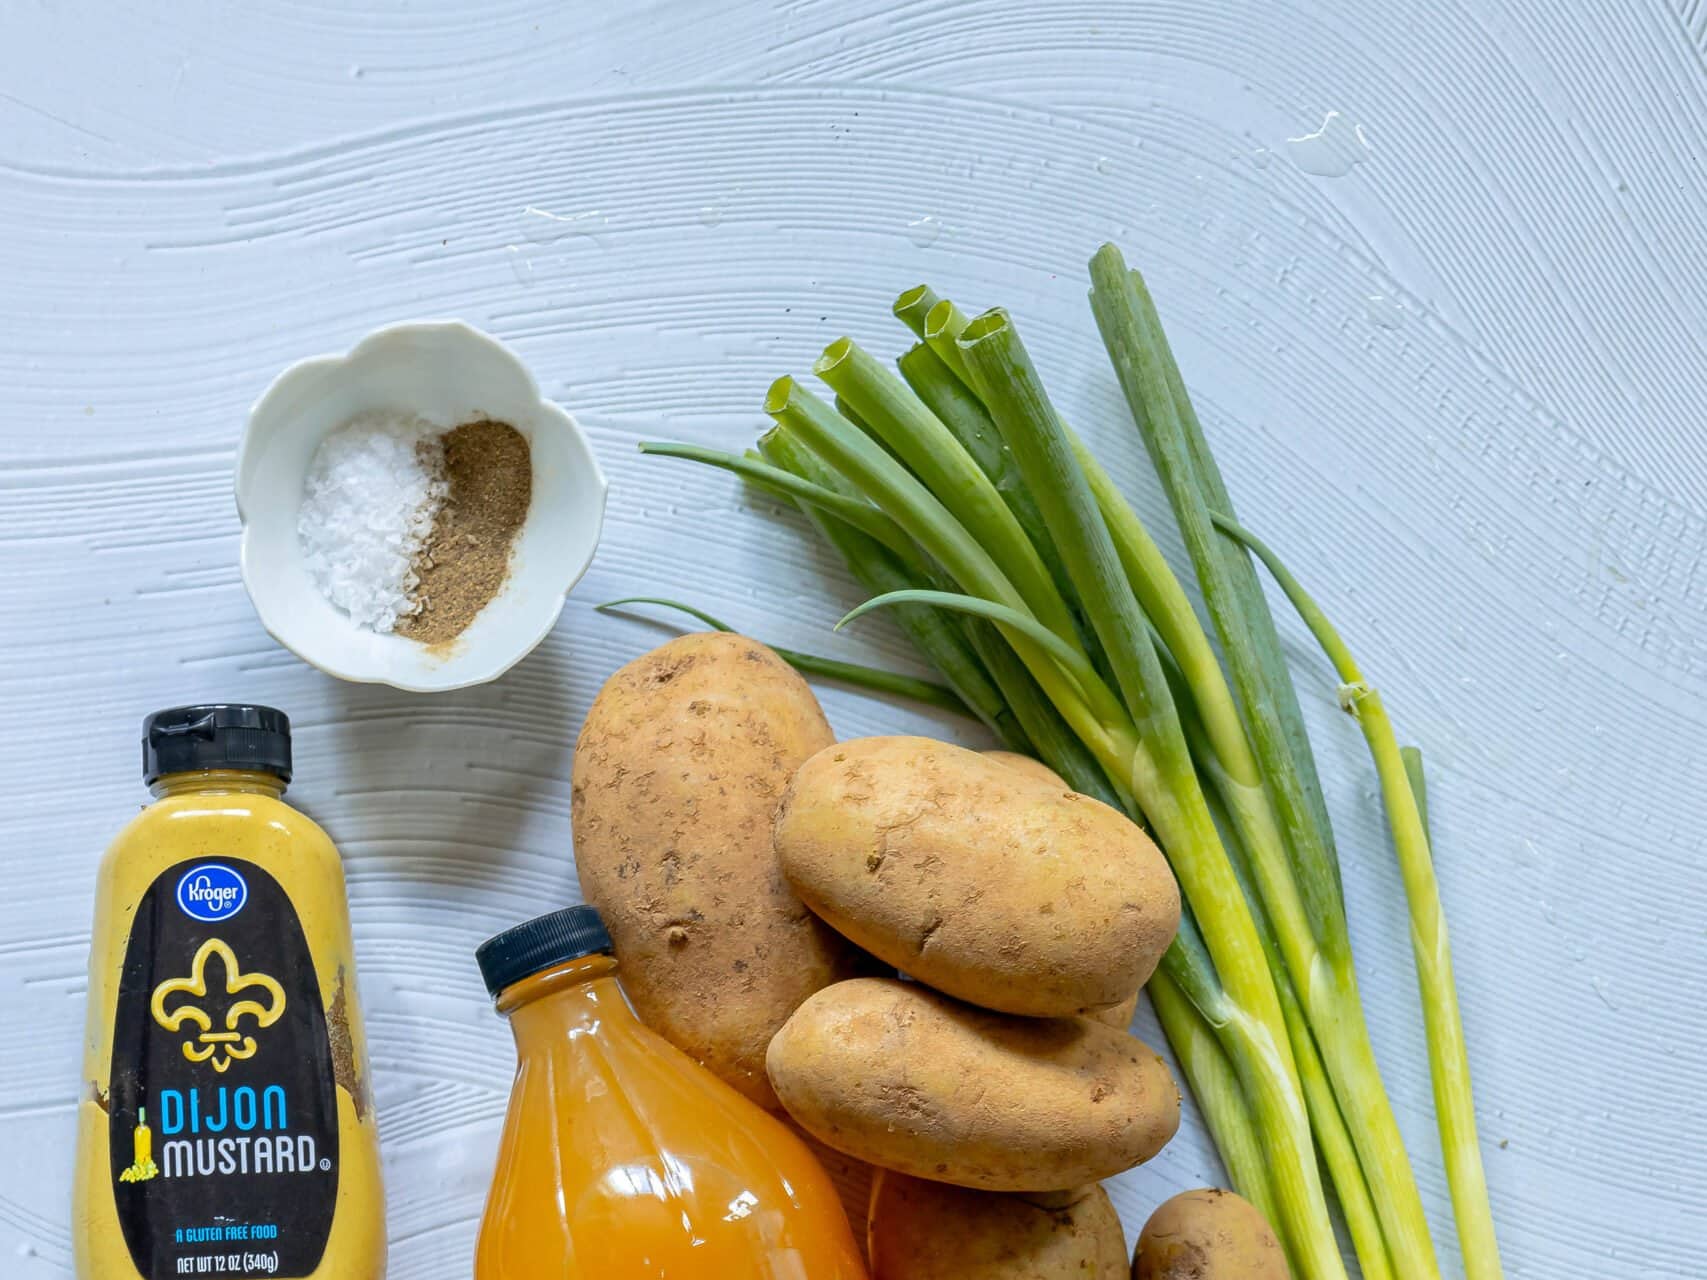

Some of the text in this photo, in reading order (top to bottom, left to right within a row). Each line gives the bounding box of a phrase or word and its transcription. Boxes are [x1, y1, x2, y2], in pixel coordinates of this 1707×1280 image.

[188, 876, 239, 911] Kroger
[161, 1084, 287, 1134] DIJON
[163, 1135, 316, 1178] MUSTARD
[175, 1224, 278, 1243] A GLUTEN FREE FOOD
[177, 1250, 279, 1274] NET WT 12 OZ (340g)
